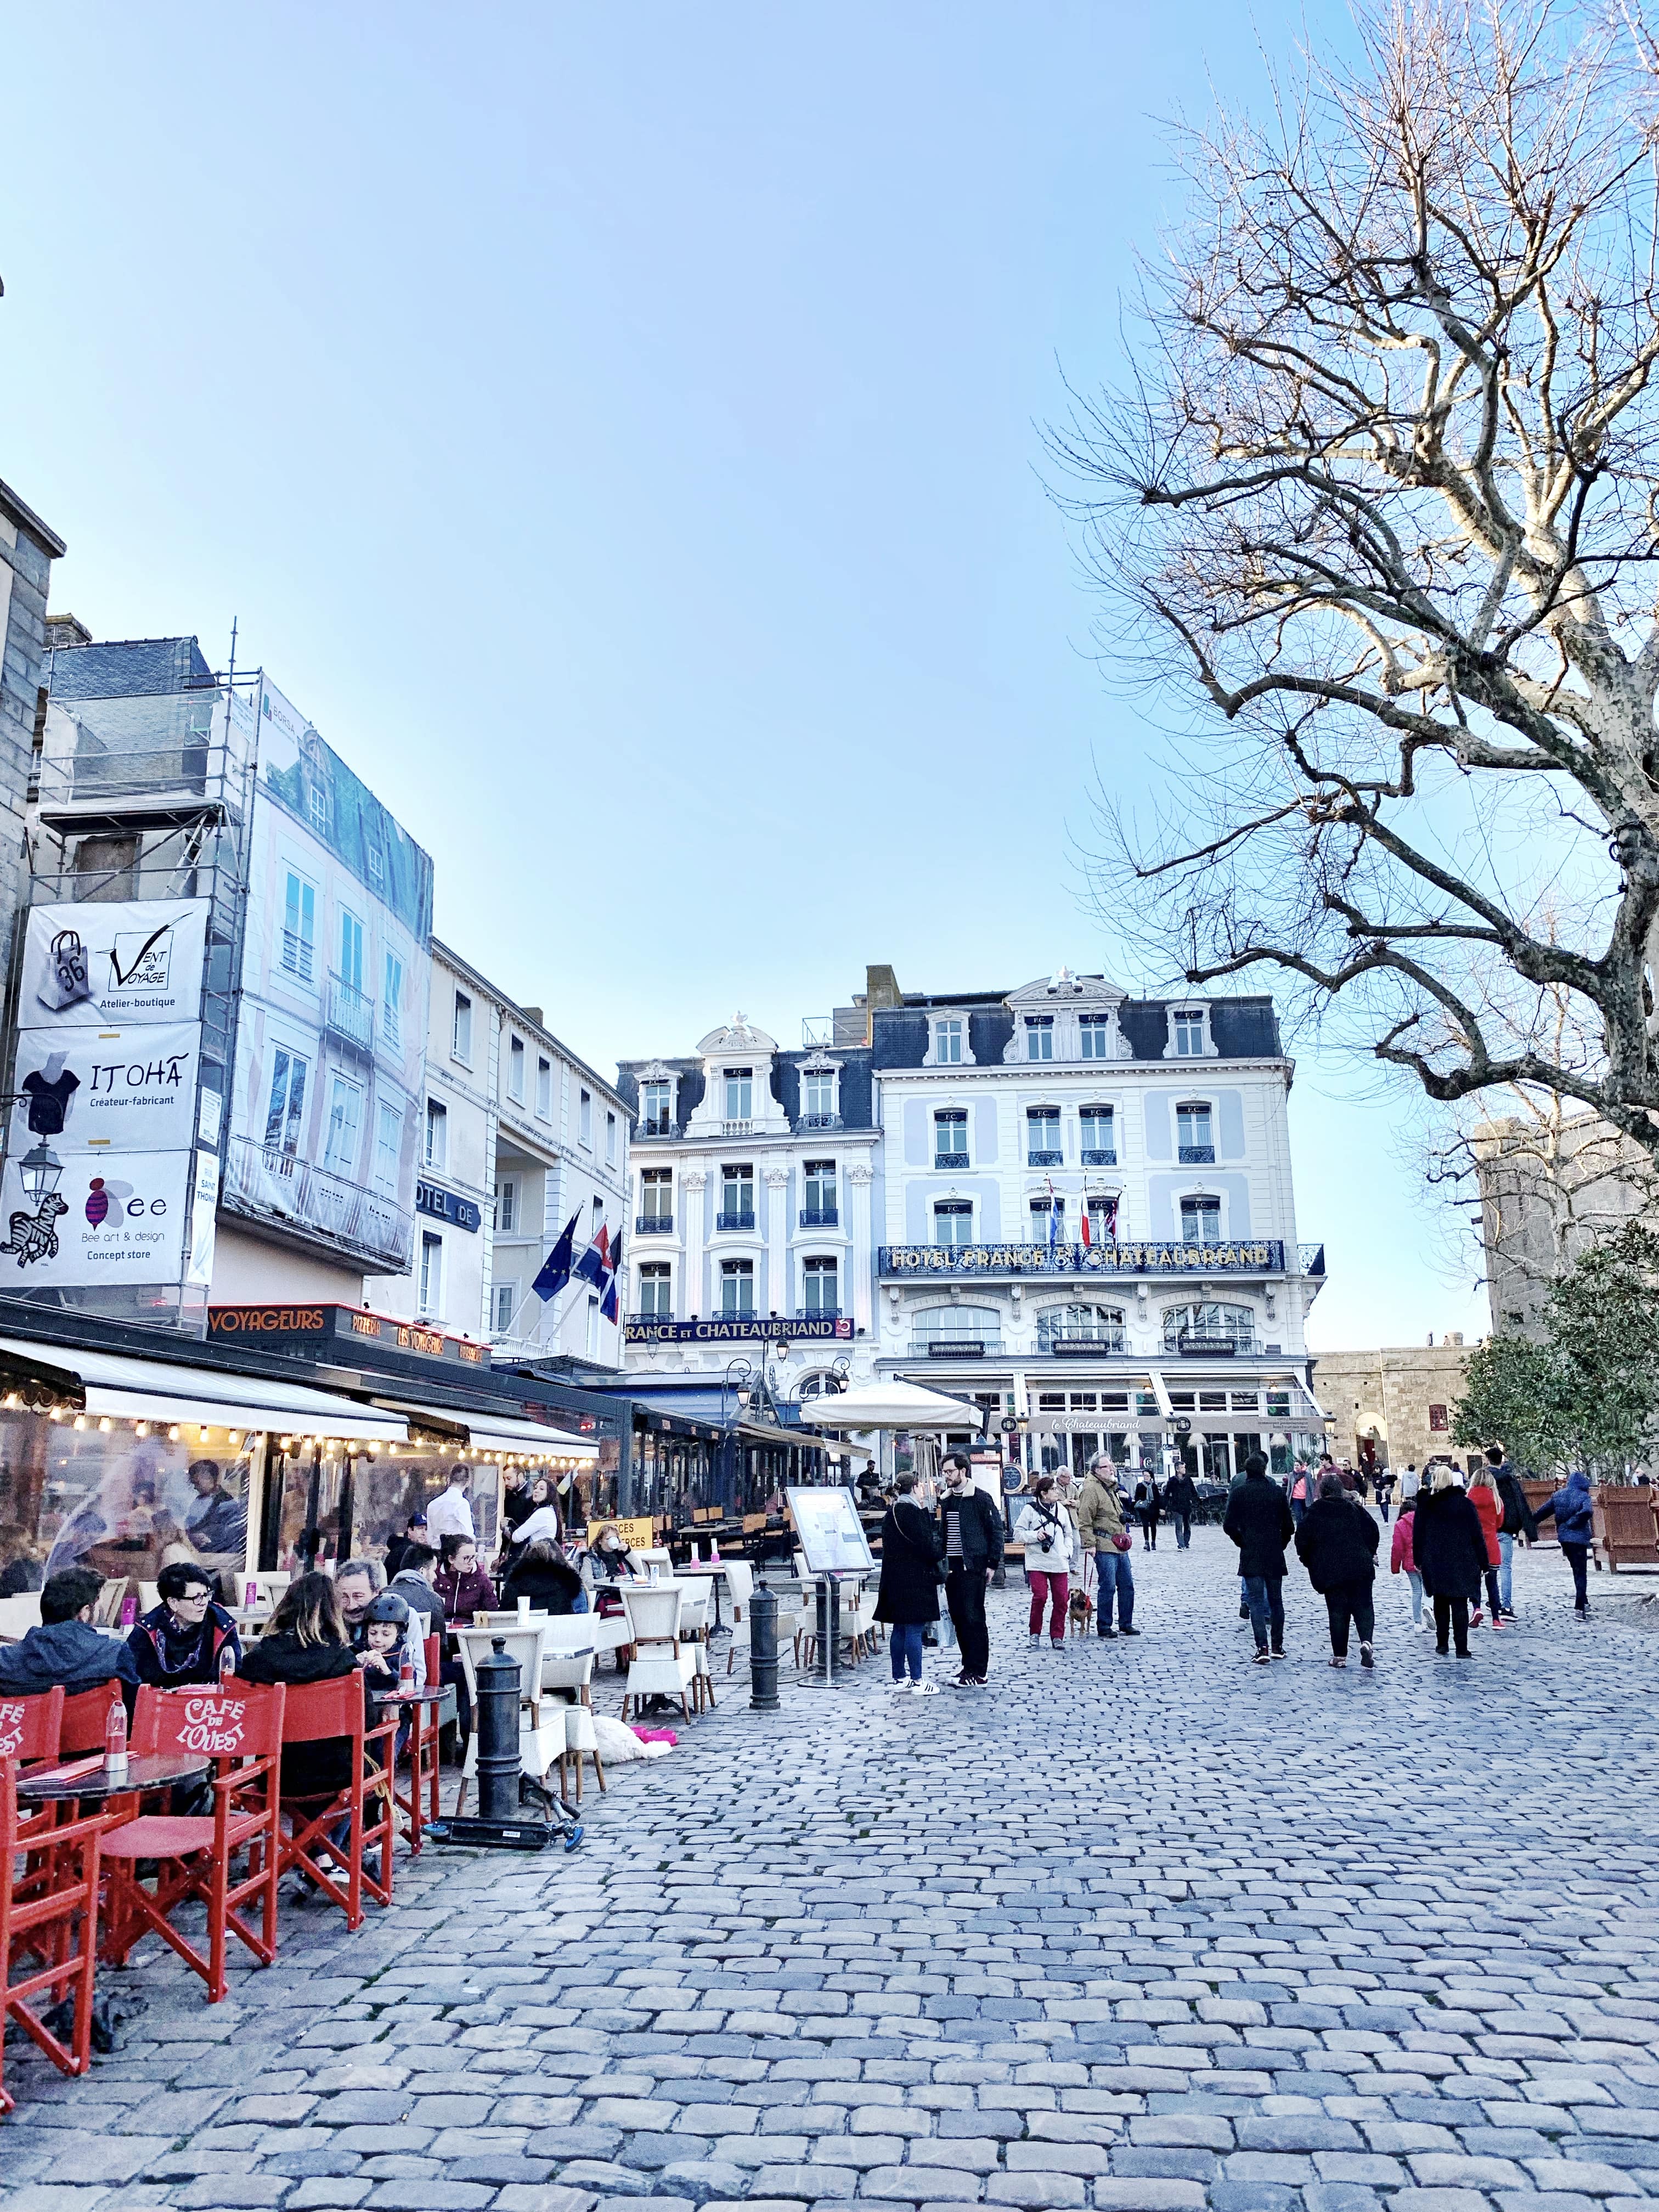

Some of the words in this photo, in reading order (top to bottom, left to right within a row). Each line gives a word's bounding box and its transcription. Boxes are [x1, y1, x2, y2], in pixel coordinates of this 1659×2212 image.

[273, 705, 295, 735] BORSA
[58, 956, 85, 992] 36
[145, 962, 155, 970] de
[100, 997, 175, 1009] Atelier-boutique
[90, 1096, 174, 1107] Créateur-fabricant
[416, 1182, 451, 1216] OTEL
[460, 1205, 473, 1225] DE
[82, 1233, 100, 1243] Bee
[104, 1233, 119, 1242] art
[124, 1232, 131, 1241] &
[135, 1231, 165, 1243] design
[87, 1251, 125, 1261] Concept
[127, 1251, 151, 1259] store
[892, 1251, 956, 1267] HOTEL
[964, 1250, 1043, 1266] FRANCE
[1090, 1249, 1267, 1265] CHATEAUBRIAND
[209, 1309, 324, 1332] VOYAGEURS
[352, 1314, 381, 1336] PIZZERIA
[397, 1327, 409, 1347] LES
[411, 1330, 444, 1356] VOYAGEURS
[626, 1324, 677, 1340] RANCE
[680, 1330, 692, 1338] ET
[696, 1321, 833, 1338] CHATEAUBRIAND
[1051, 1419, 1061, 1430] le
[1062, 1417, 1141, 1431] Chateaubriand
[185, 1698, 245, 1724] CAFÉ
[207, 1716, 223, 1726] DE
